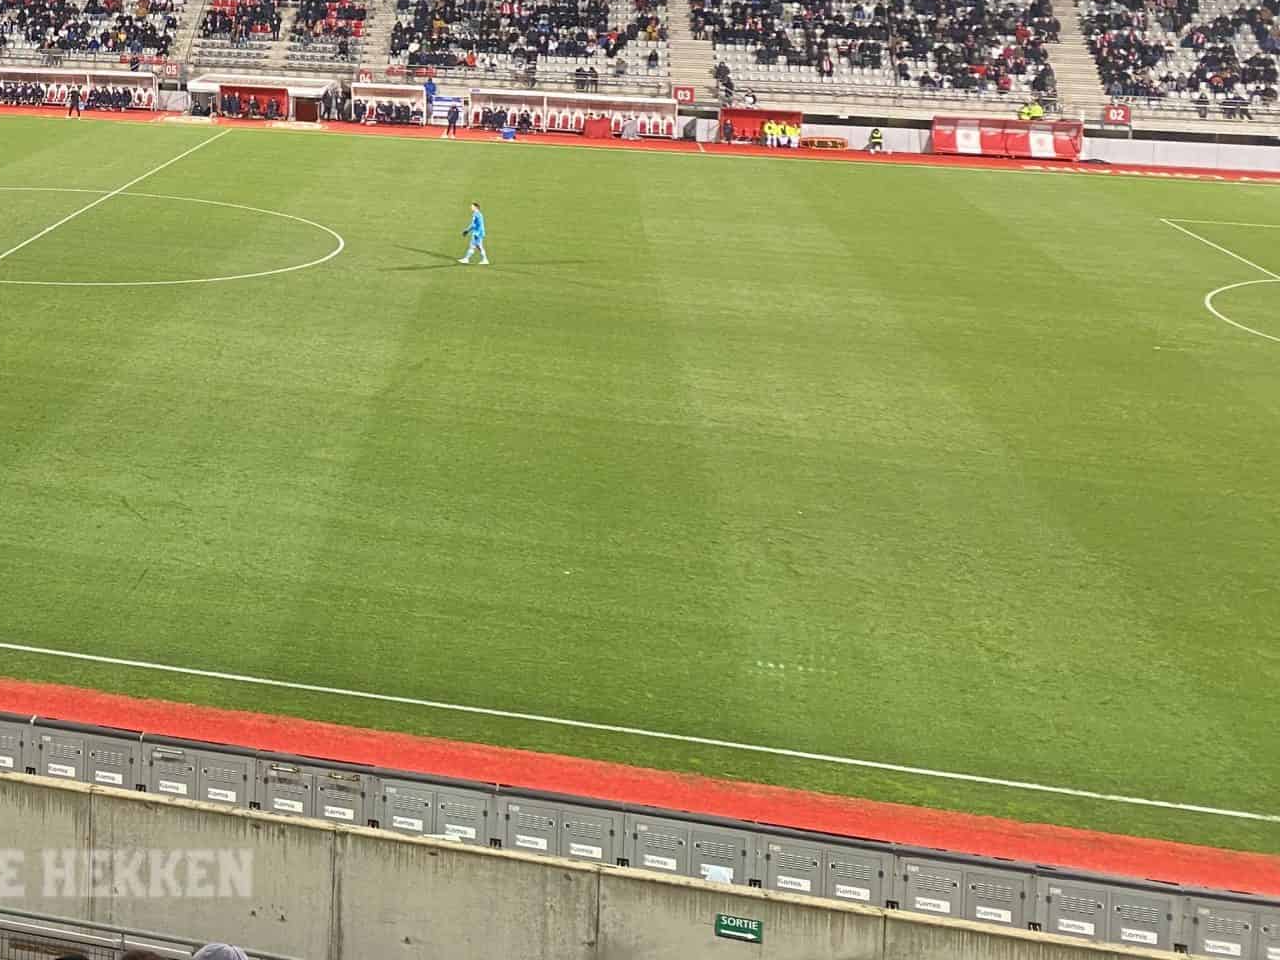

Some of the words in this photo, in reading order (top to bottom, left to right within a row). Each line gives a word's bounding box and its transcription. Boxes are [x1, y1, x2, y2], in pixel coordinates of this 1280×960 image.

[165, 64, 177, 75] 05
[677, 88, 691, 101] 03
[1109, 109, 1124, 121] 02
[720, 915, 759, 930] SORTIE
